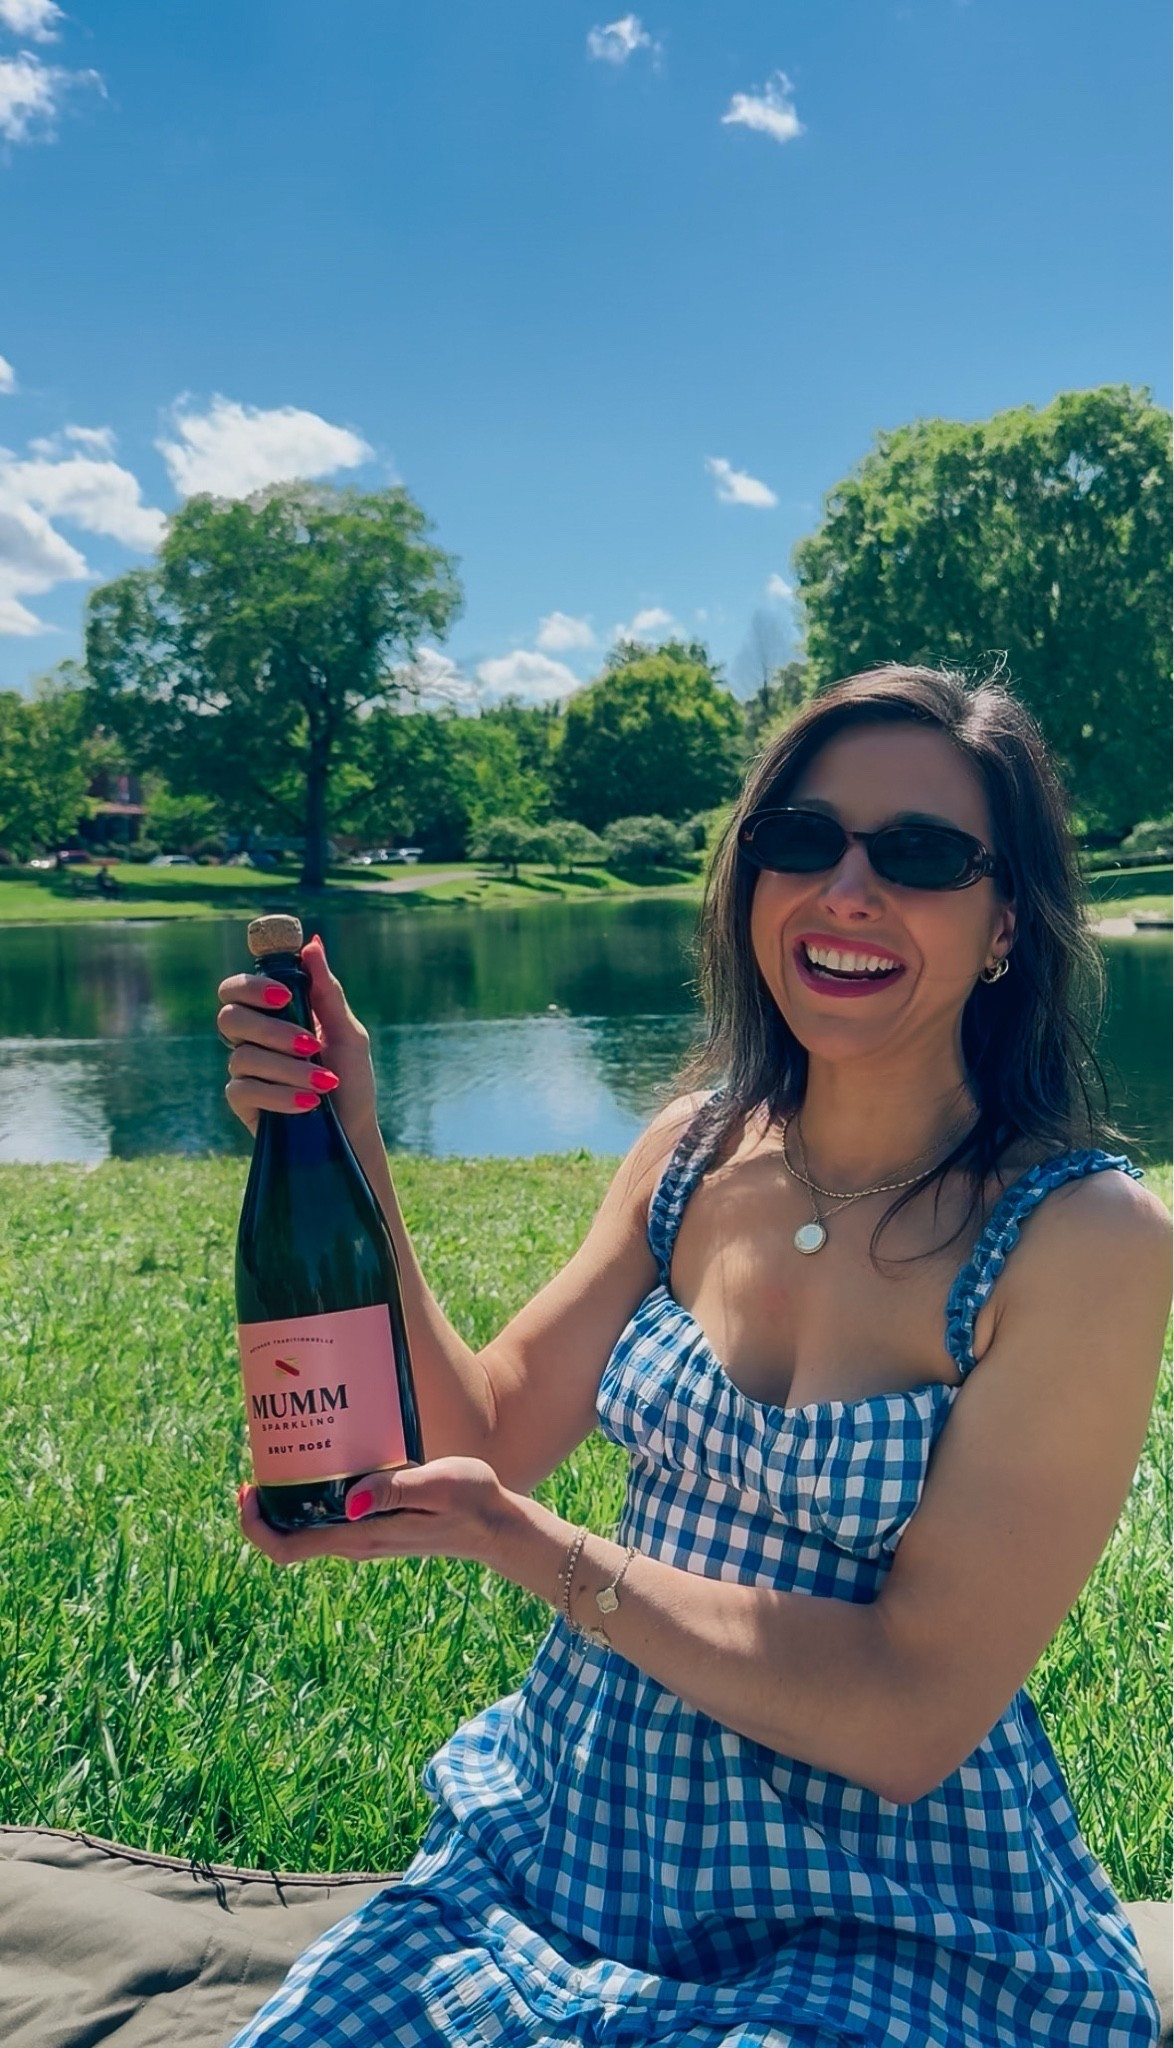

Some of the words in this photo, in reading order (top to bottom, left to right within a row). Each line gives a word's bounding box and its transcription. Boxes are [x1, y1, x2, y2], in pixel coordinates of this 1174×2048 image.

[252, 1384, 349, 1419] MUMM
[262, 1416, 335, 1432] SPARKLING
[268, 1445, 294, 1454] BRUT
[299, 1438, 332, 1452] ROSÉ
